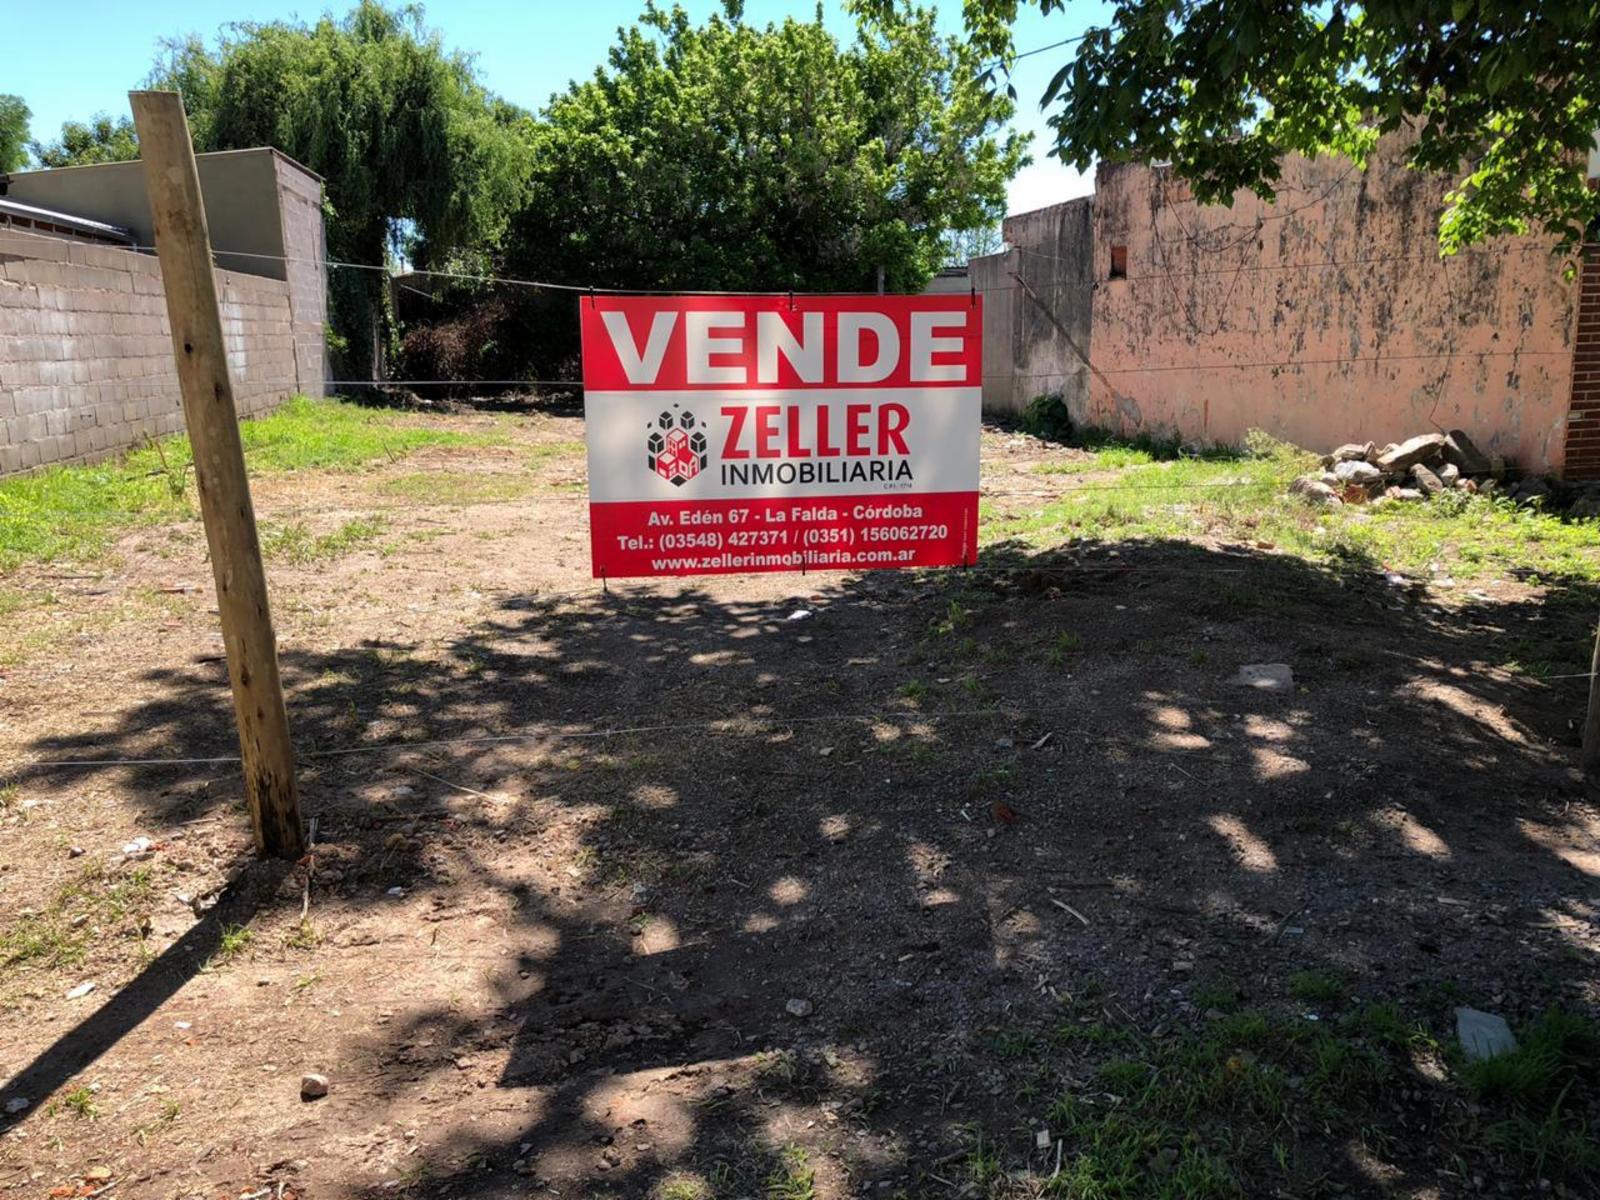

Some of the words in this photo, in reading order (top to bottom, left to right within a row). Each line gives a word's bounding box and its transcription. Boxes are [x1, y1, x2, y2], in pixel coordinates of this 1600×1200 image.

[600, 311, 967, 384] VENDE
[720, 403, 910, 459] ZELLER
[721, 460, 913, 486] INMOBILIARIA
[648, 512, 674, 526] Av.
[680, 510, 723, 525] Edén
[728, 509, 749, 524] 67
[765, 508, 786, 522] La
[792, 507, 837, 521] Falda
[853, 505, 922, 520] Córdoba
[617, 536, 653, 550] Tel.:
[659, 533, 723, 552] (03548)
[728, 530, 787, 546] 427371
[793, 530, 799, 544] /
[803, 528, 854, 546] (0351)
[861, 525, 948, 541] 156062720
[652, 549, 915, 570] www.zellerinmobiliaria.com.ar
